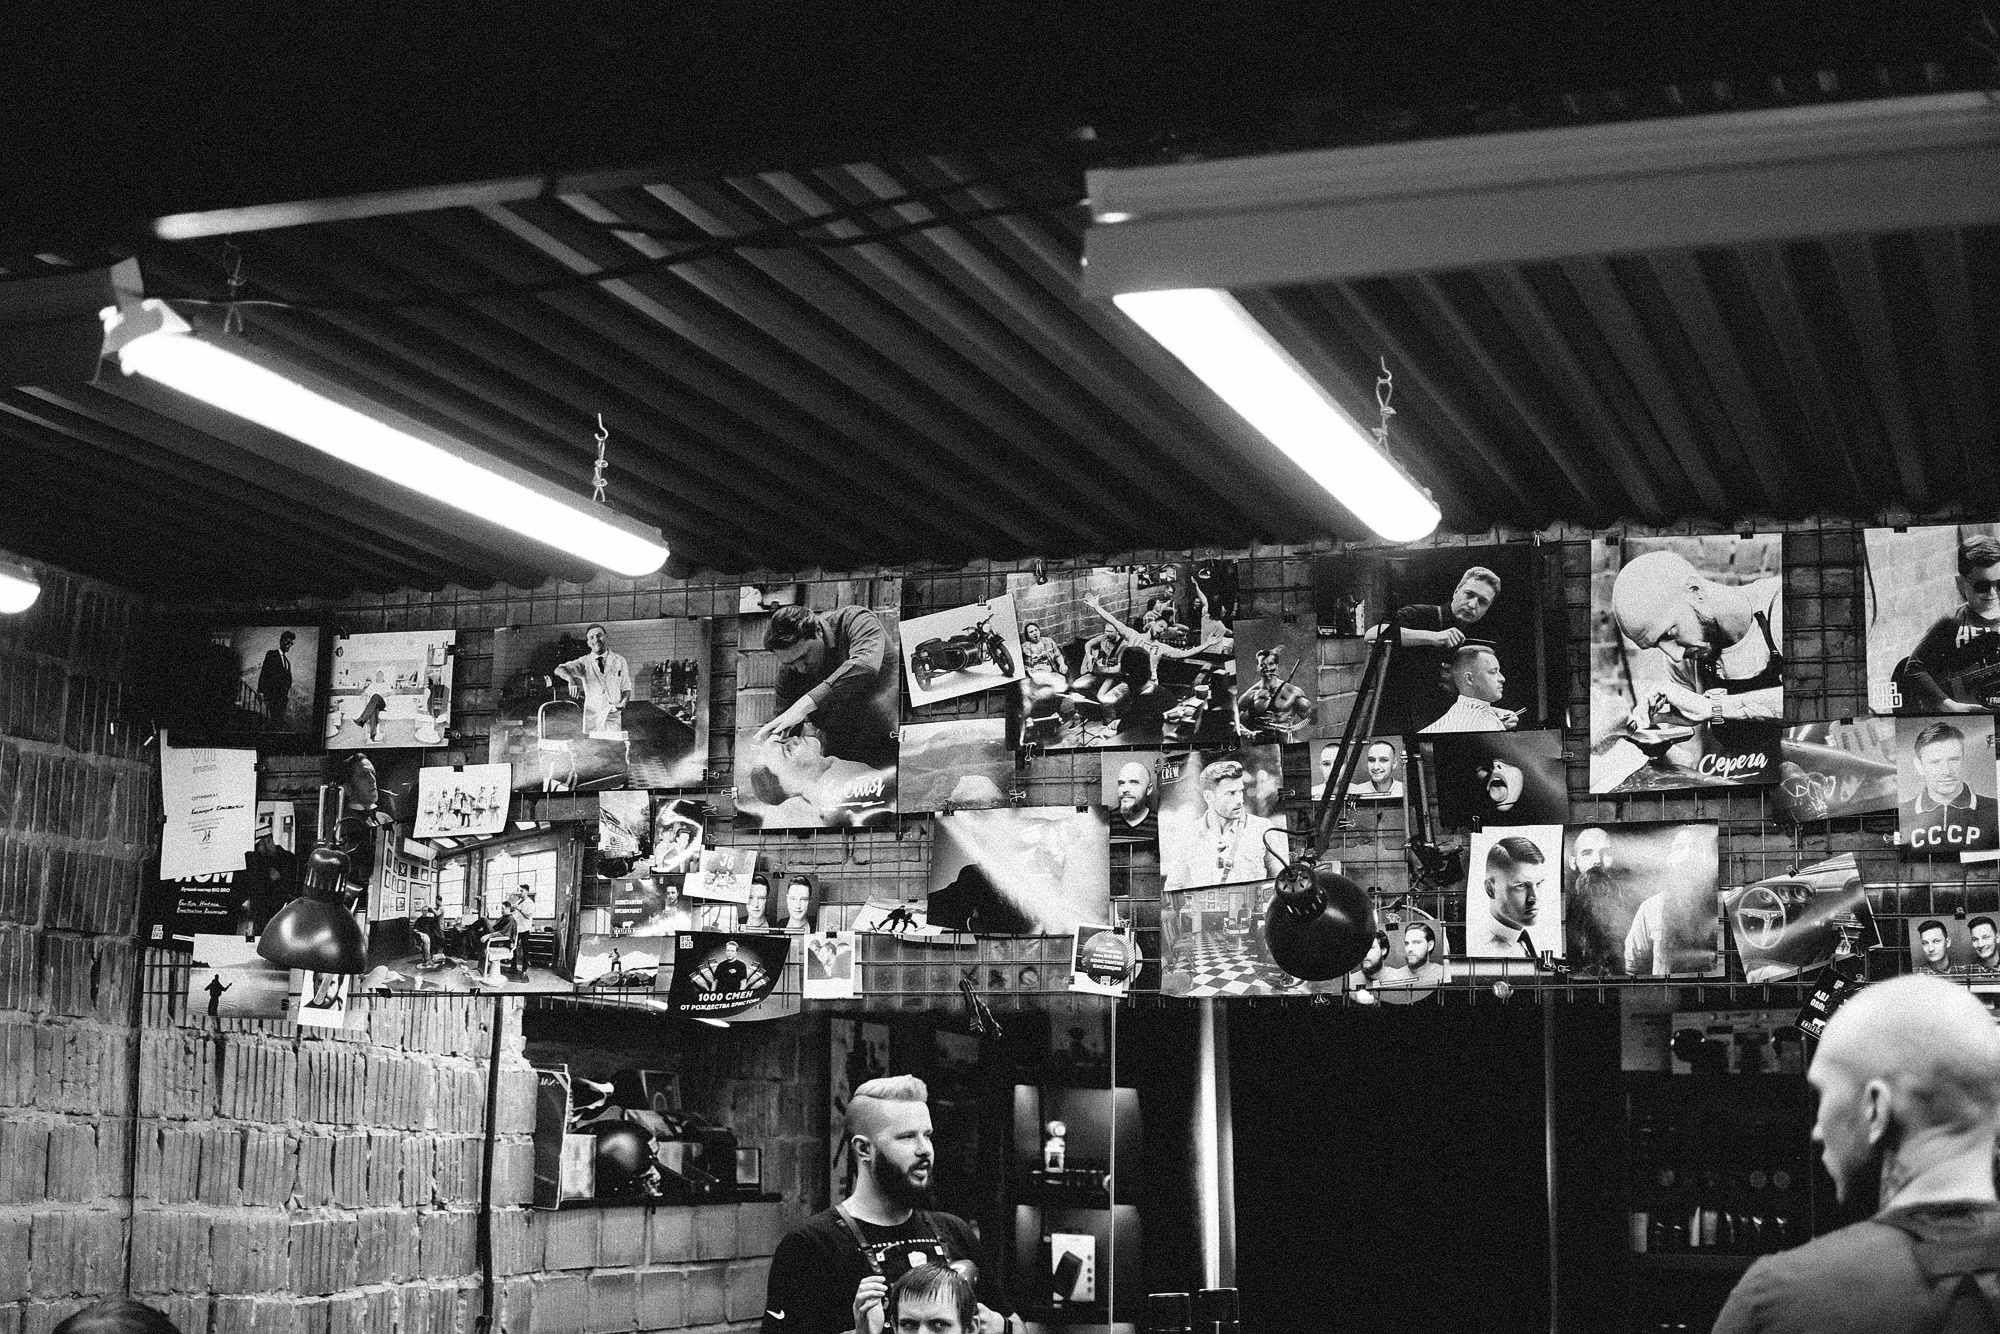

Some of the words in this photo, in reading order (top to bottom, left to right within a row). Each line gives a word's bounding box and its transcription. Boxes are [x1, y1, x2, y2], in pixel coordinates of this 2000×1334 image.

[1911, 824, 1981, 848] СССР
[698, 992, 724, 1002] 1000
[725, 990, 754, 1001] СМЕН
[690, 1002, 730, 1011] РОЖДЕСТВА
